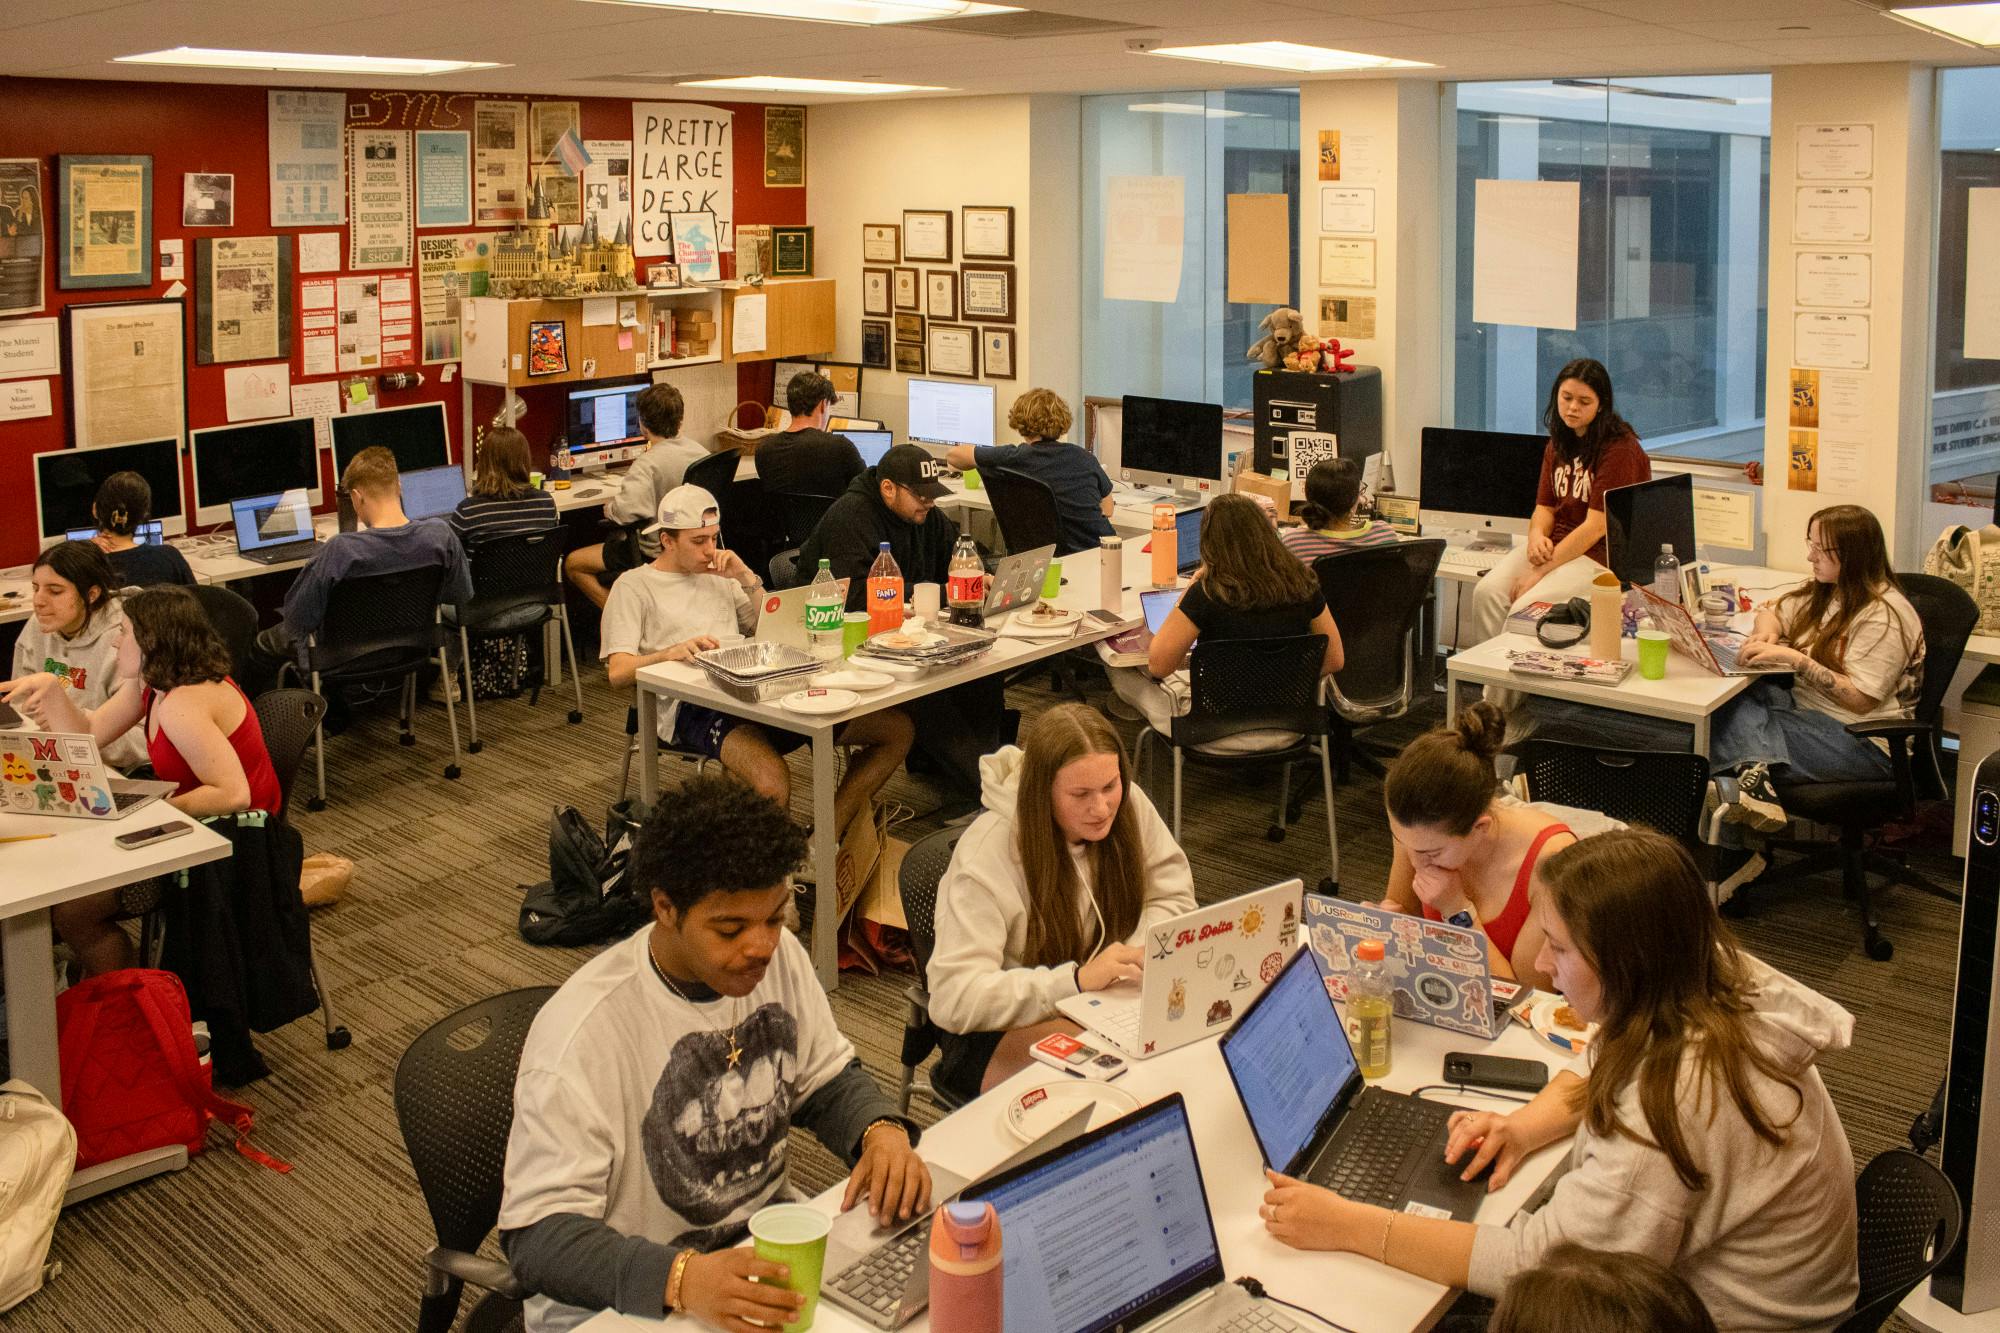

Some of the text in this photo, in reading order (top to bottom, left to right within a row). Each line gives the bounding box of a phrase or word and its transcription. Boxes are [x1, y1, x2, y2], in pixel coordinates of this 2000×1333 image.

[644, 116, 728, 146] PRETTY
[642, 151, 722, 181] LARGE
[362, 193, 400, 201] CAPTURE
[642, 189, 718, 216] DESK
[362, 213, 401, 221] DEVELOP
[421, 239, 453, 251] DESIGN
[368, 253, 396, 262] SHOT
[422, 250, 453, 260] TIPS
[680, 256, 712, 264] Standard
[14, 337, 40, 346] Miami
[4, 350, 34, 358] Student
[876, 588, 896, 599] FANT
[27, 737, 63, 762] M
[1176, 920, 1234, 948] Tri Delta
